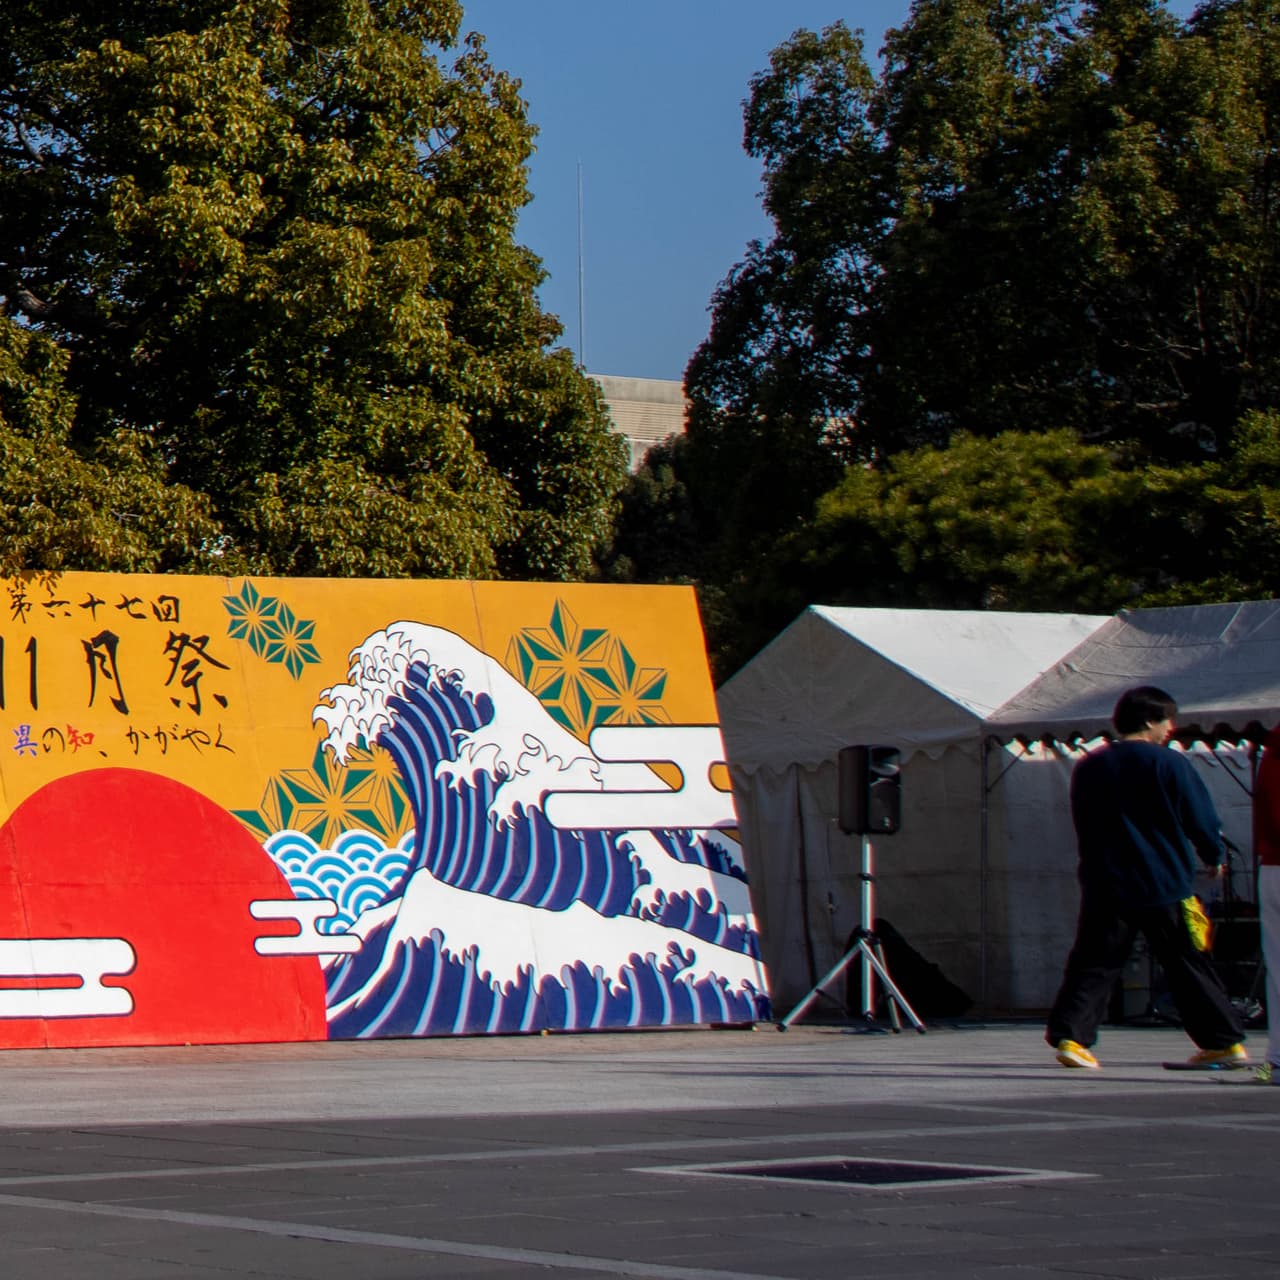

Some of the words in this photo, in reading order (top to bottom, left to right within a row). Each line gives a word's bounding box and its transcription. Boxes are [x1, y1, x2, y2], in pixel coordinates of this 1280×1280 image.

[6, 580, 180, 624] 第六十七回
